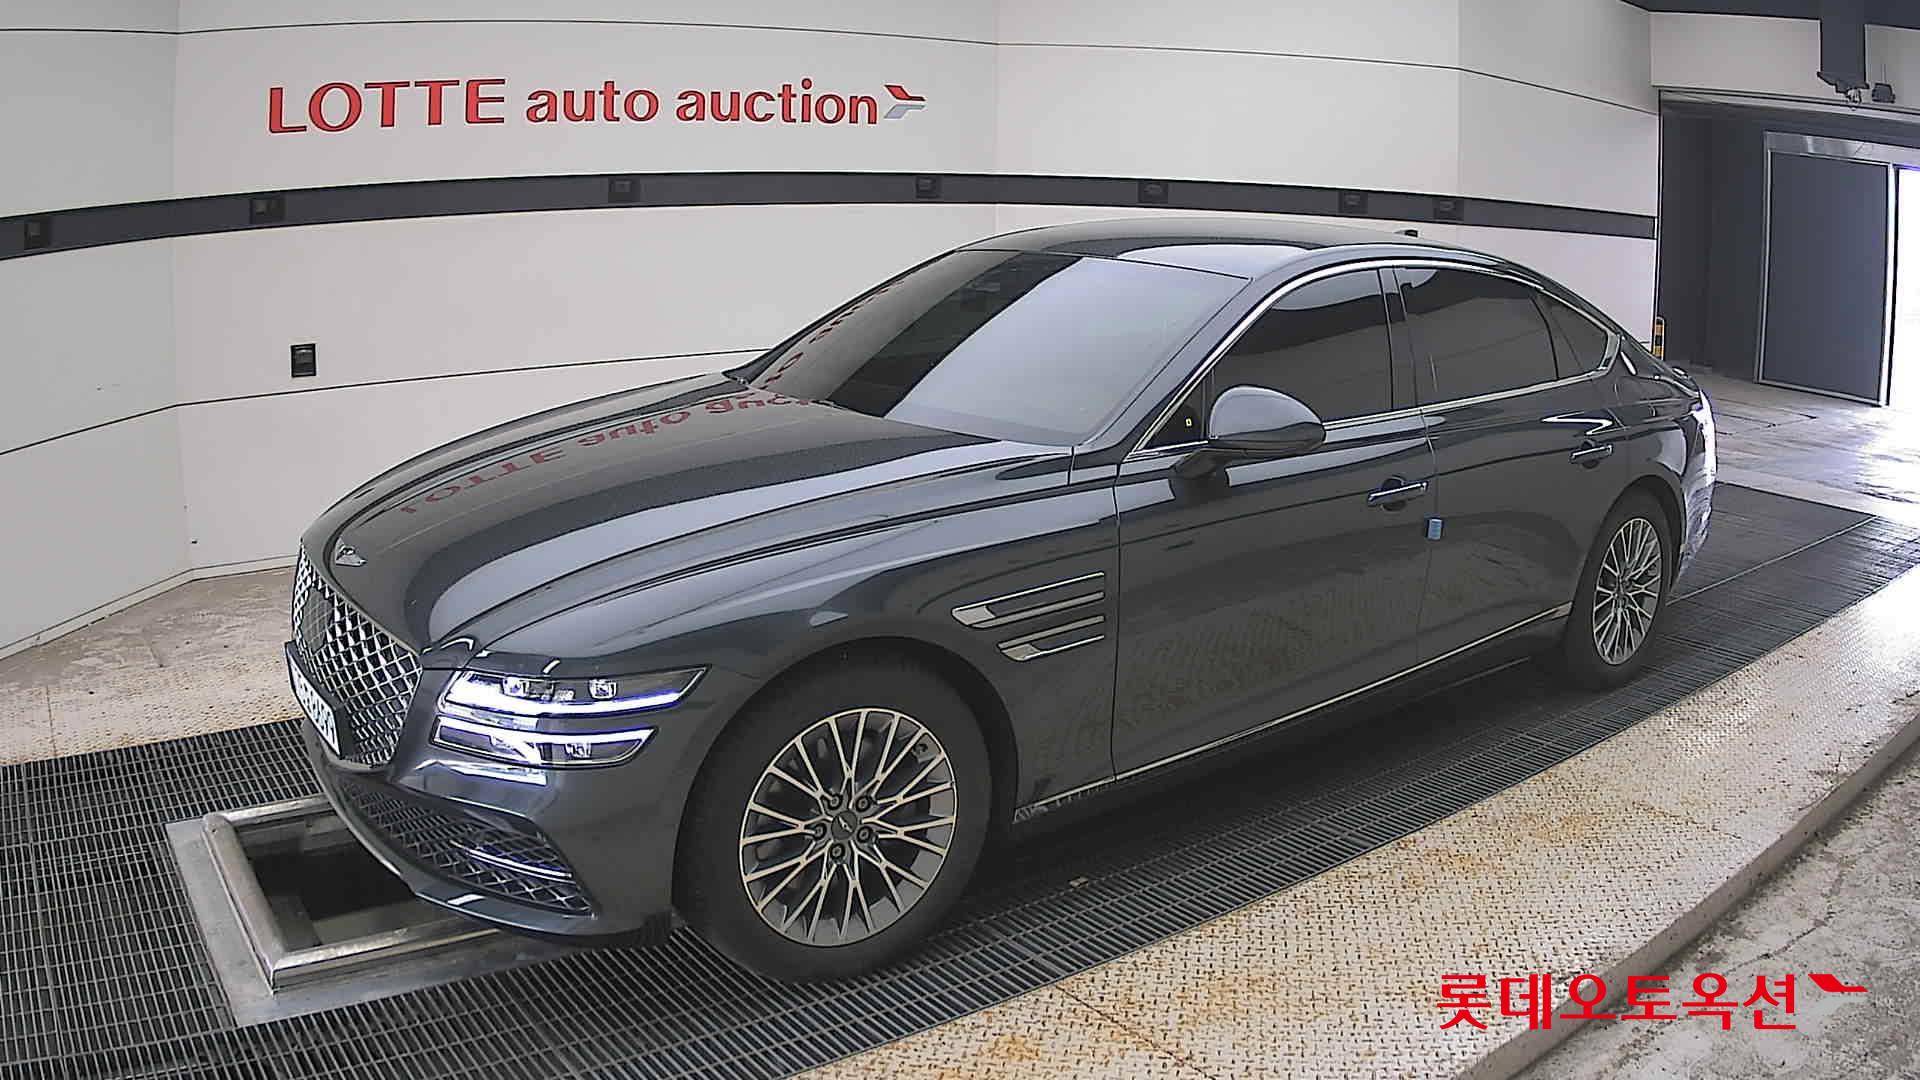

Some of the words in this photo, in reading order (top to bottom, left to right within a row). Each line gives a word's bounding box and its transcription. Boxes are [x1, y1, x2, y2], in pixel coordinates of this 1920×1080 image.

[268, 79, 504, 133] LOTTE
[526, 80, 660, 123] auto
[676, 78, 878, 124] auction
